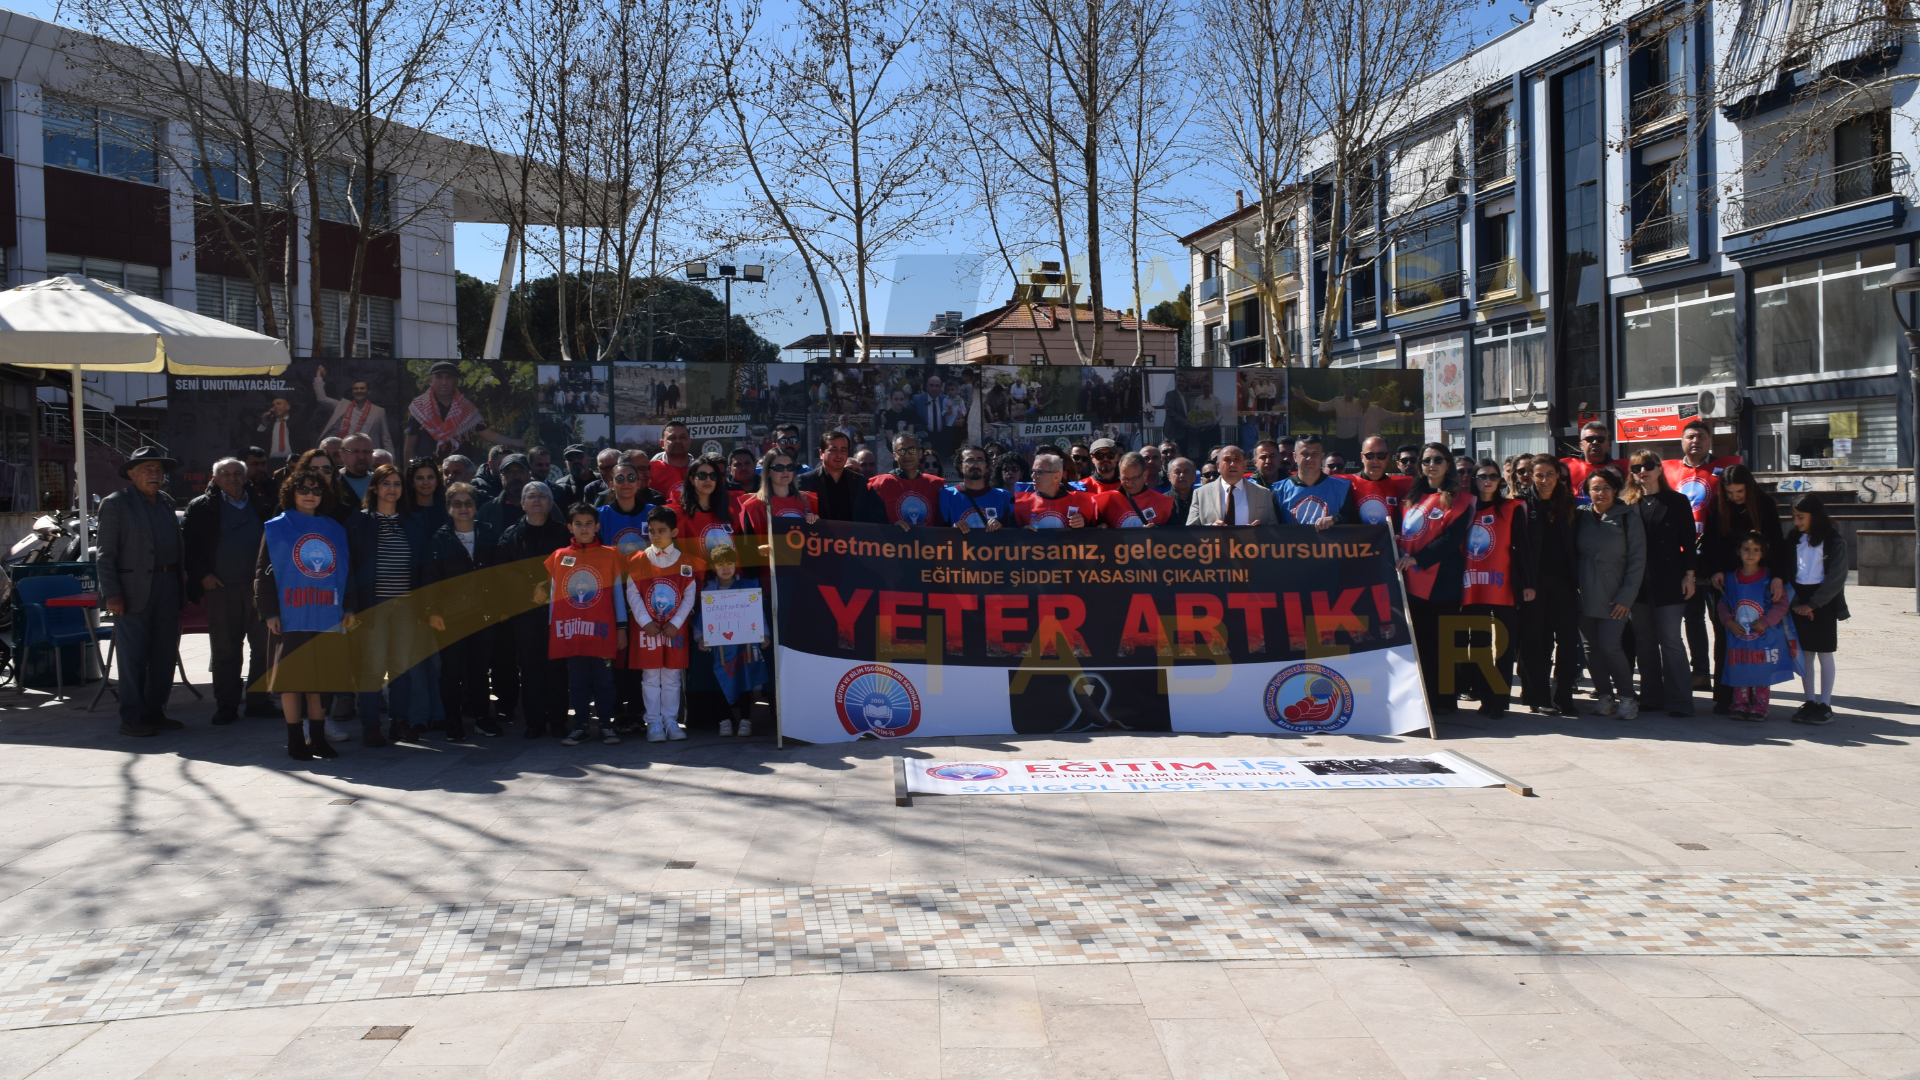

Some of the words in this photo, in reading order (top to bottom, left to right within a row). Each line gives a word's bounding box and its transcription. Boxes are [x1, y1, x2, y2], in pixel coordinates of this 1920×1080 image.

[175, 377, 199, 390] SENİ
[715, 414, 751, 423] DURMADAN
[688, 425, 740, 438] IŞIYORUZ
[1025, 423, 1042, 434] BİR
[1045, 423, 1086, 434] BAŞKAN
[786, 525, 953, 561] Öğretmenleri
[962, 540, 1106, 562] korursanız,
[1114, 538, 1220, 565] geleceği
[1229, 538, 1380, 559] korursunuz.
[921, 566, 1005, 584] EĞİTİMDE
[1010, 568, 1072, 587] ŞİDDET
[1077, 569, 1158, 584] YASASINI
[1162, 569, 1249, 586] ÇIKARTIN!
[817, 584, 1092, 658] YETER
[1117, 582, 1397, 658] ARTIK!
[849, 668, 865, 679] BİLİM
[1025, 760, 1287, 773] EĞİTİM-İŞ
[961, 782, 1120, 793] SARIGÖL
[1128, 782, 1208, 791] İLÇE
[1215, 778, 1445, 790] TEMSİLCİLİĞİ
